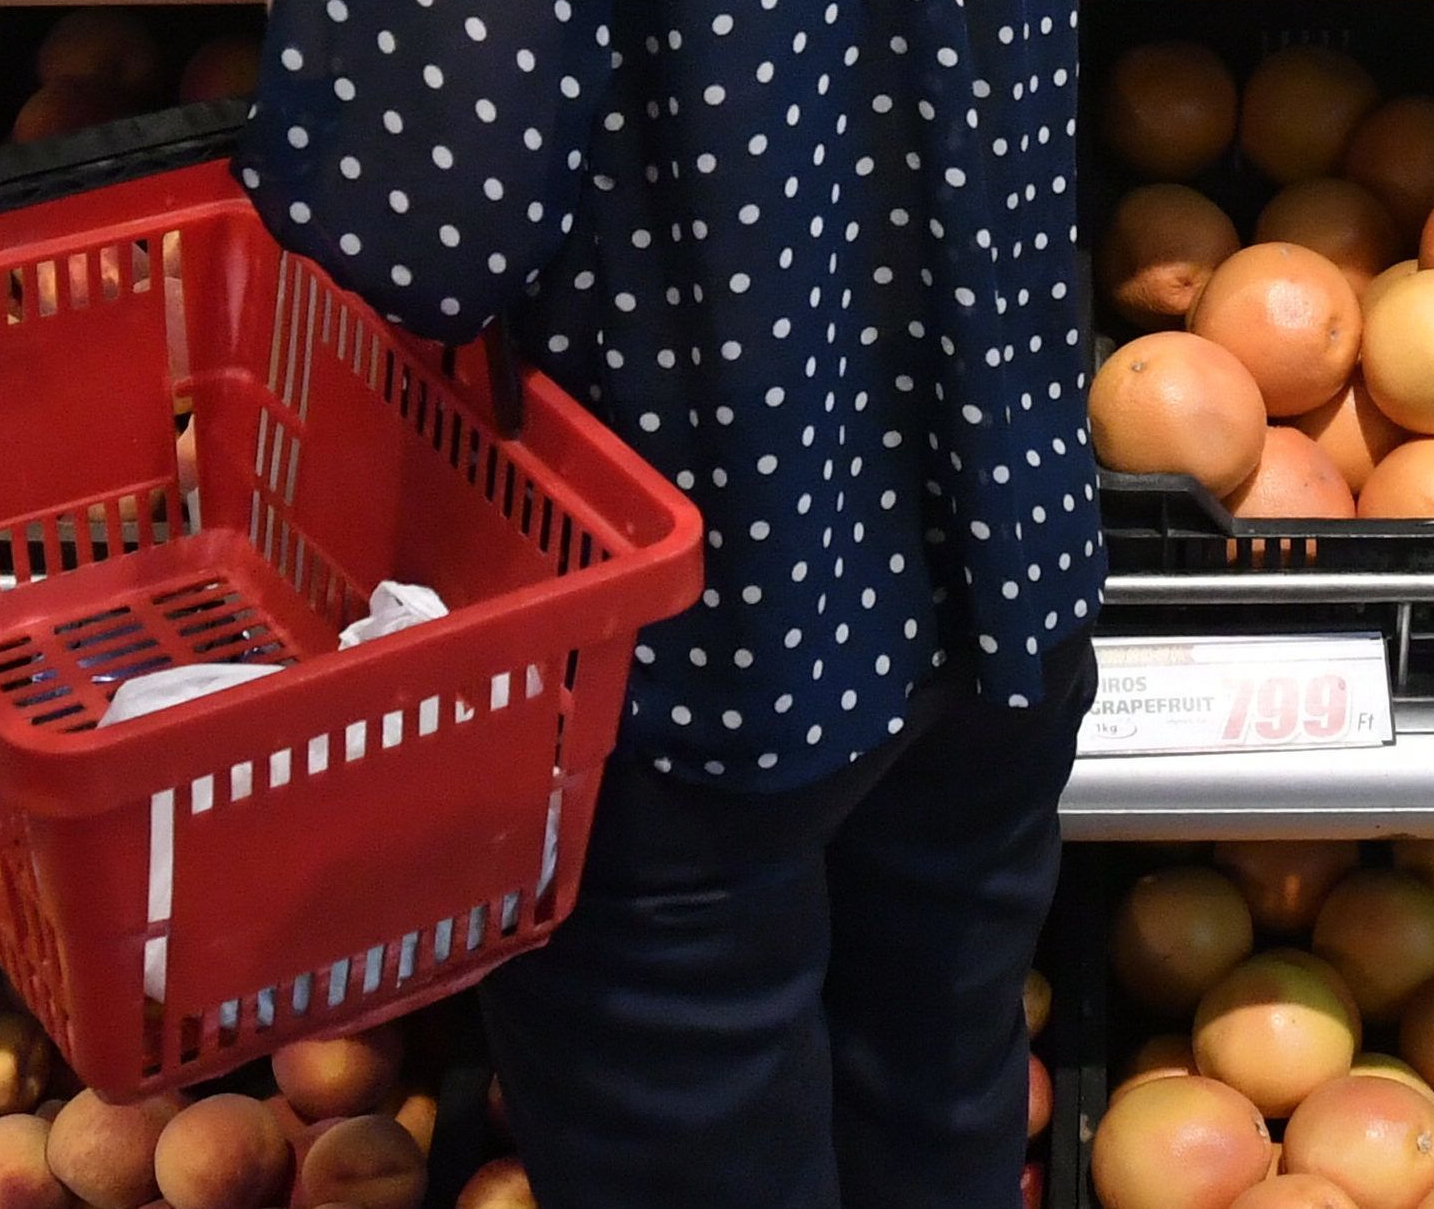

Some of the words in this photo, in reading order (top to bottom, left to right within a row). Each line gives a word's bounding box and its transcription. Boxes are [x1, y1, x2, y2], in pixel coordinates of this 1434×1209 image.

[1102, 676, 1148, 693] IROS
[1221, 674, 1348, 740] 799
[1357, 712, 1375, 731] Ft
[1096, 723, 1118, 735] 1kg
